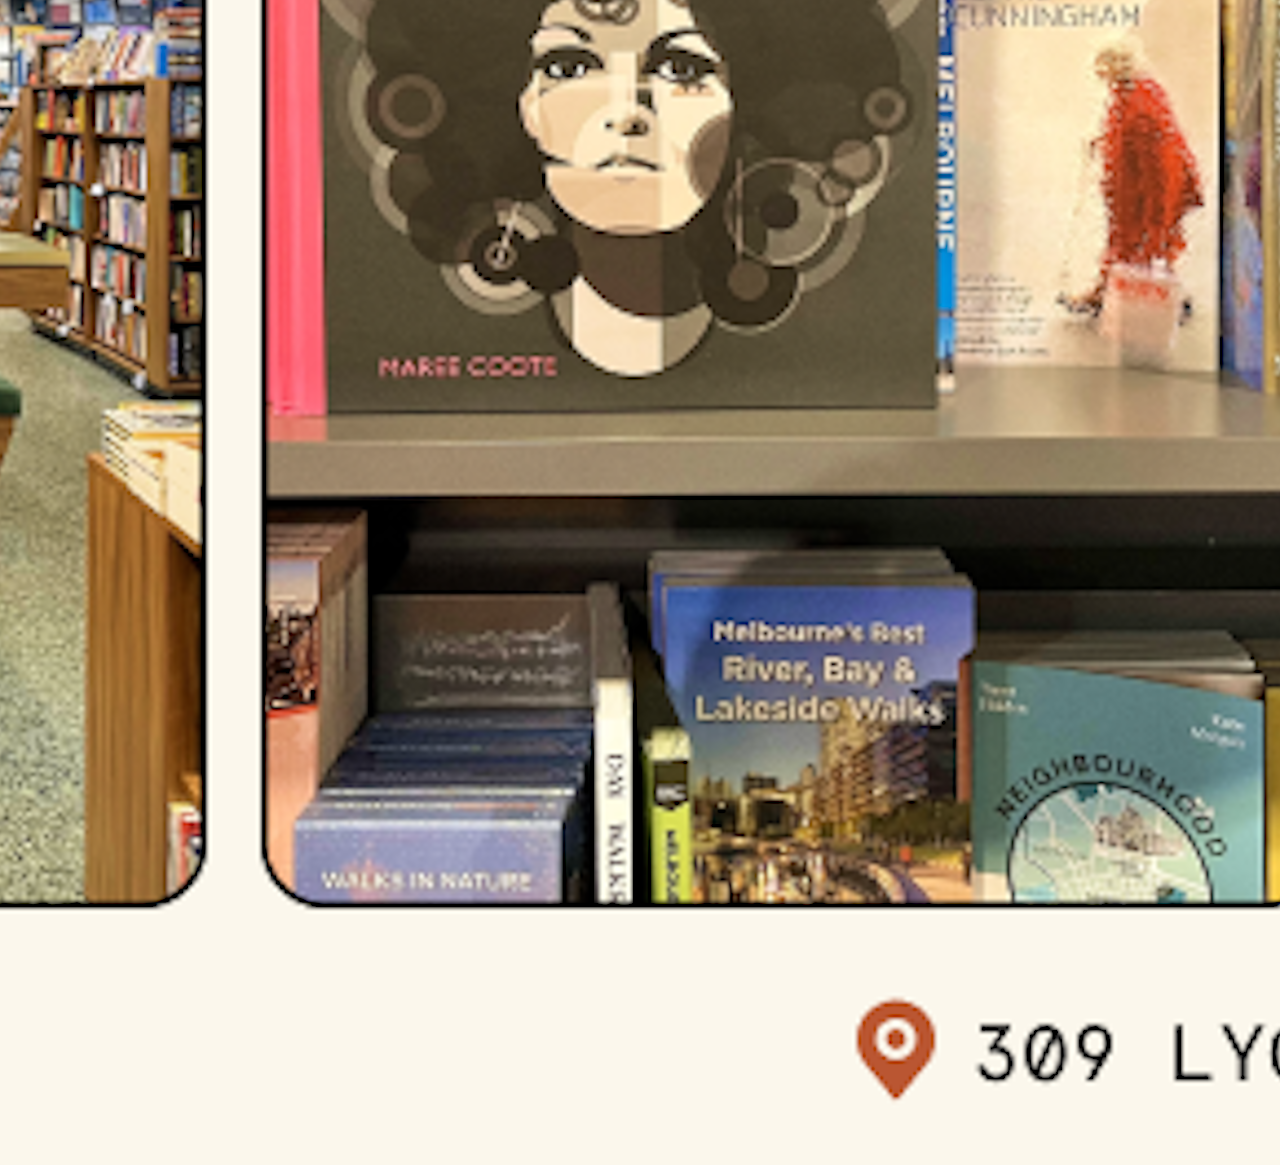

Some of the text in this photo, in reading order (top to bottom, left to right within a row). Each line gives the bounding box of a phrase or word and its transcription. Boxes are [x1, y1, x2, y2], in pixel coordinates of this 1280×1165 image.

[955, 3, 1141, 30] CUNNINGHAM
[377, 355, 559, 378] MAREE COOTE
[713, 620, 925, 645] Melbourne's Best
[723, 655, 917, 688] River, Bay &
[695, 695, 841, 722] Lakeside
[847, 695, 947, 725] Walks
[996, 753, 1230, 859] NEIGHBOURHOOD
[321, 871, 532, 893] WALKS IN NATURE
